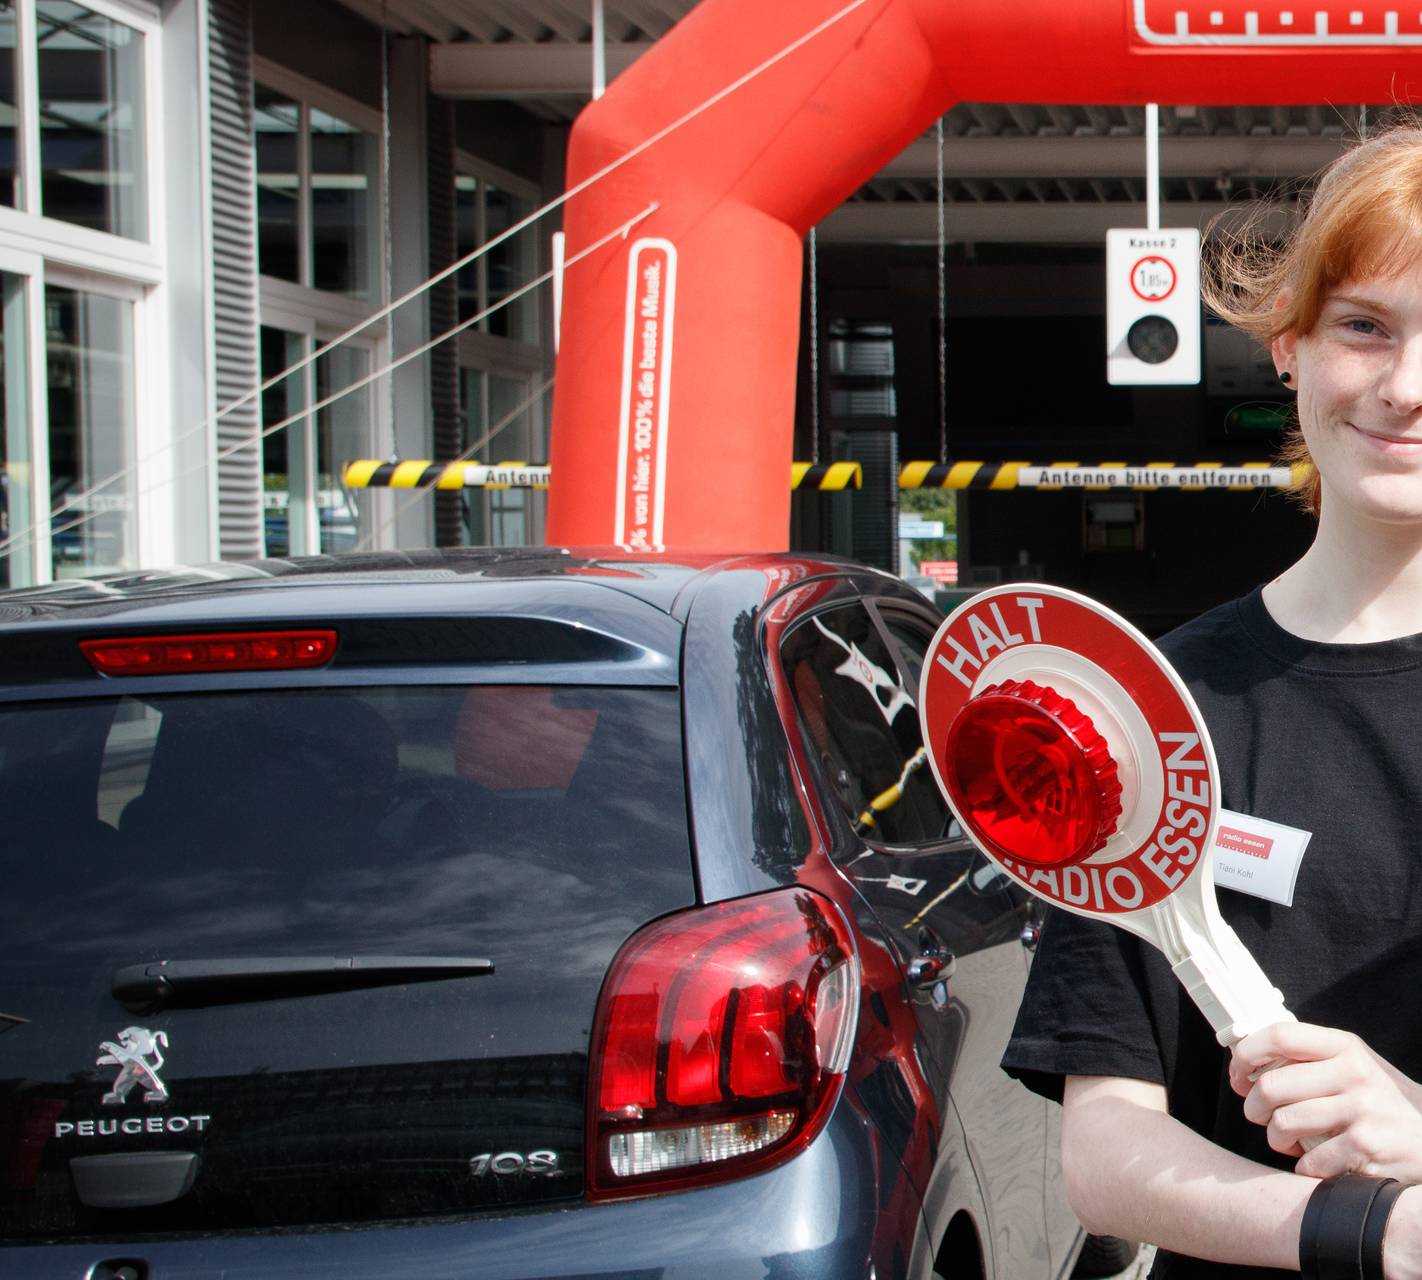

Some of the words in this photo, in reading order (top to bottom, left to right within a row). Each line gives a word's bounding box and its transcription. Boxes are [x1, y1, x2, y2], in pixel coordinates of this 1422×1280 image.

[1129, 238, 1165, 248] Kasse
[639, 319, 658, 369] beste
[637, 370, 655, 398] die
[634, 399, 654, 452] 100%
[486, 470, 551, 485] Antenn
[1039, 470, 1117, 485] Antenne
[1126, 470, 1170, 485] bitte
[1178, 470, 1272, 485] entfernen
[634, 494, 648, 526] von
[937, 596, 1044, 688] HALT
[1139, 732, 1209, 890] ESSEN
[1223, 833, 1242, 842] radio
[1244, 838, 1265, 849] essen
[55, 1115, 210, 1138] PEUGEOT
[470, 1150, 557, 1175] 108
